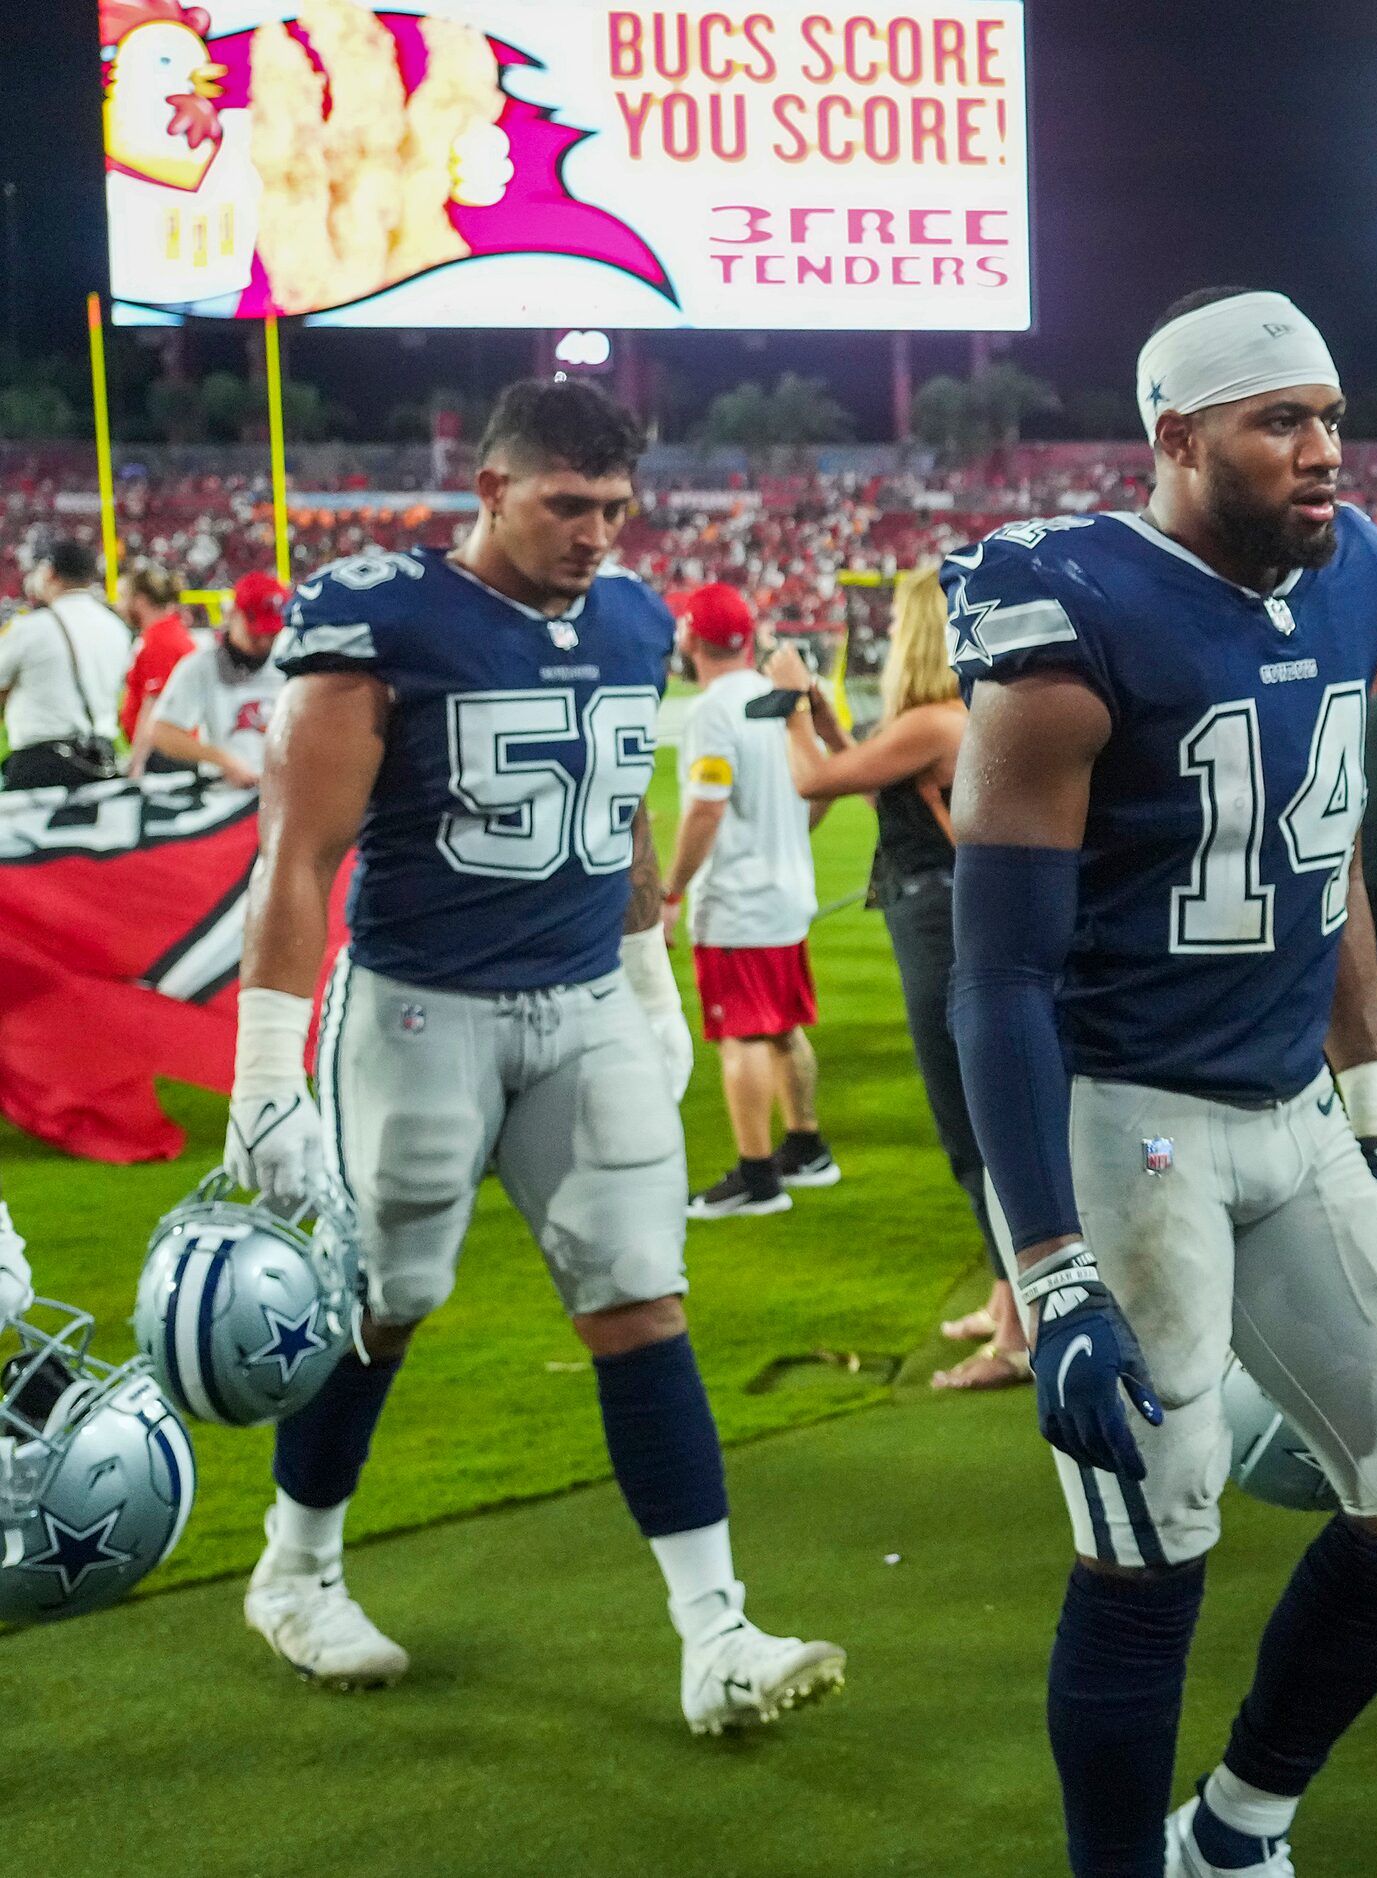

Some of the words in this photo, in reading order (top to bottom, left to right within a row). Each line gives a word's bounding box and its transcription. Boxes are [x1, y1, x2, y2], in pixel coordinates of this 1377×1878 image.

[608, 11, 777, 83] BUCS
[801, 14, 1006, 87] SCORE
[615, 91, 748, 162] YOU
[772, 93, 1007, 165] SCORE!
[709, 205, 773, 244] 3
[789, 207, 1009, 245] FREE
[710, 254, 1008, 287] TENDERS
[436, 684, 661, 881] 56
[1168, 679, 1369, 955] 14
